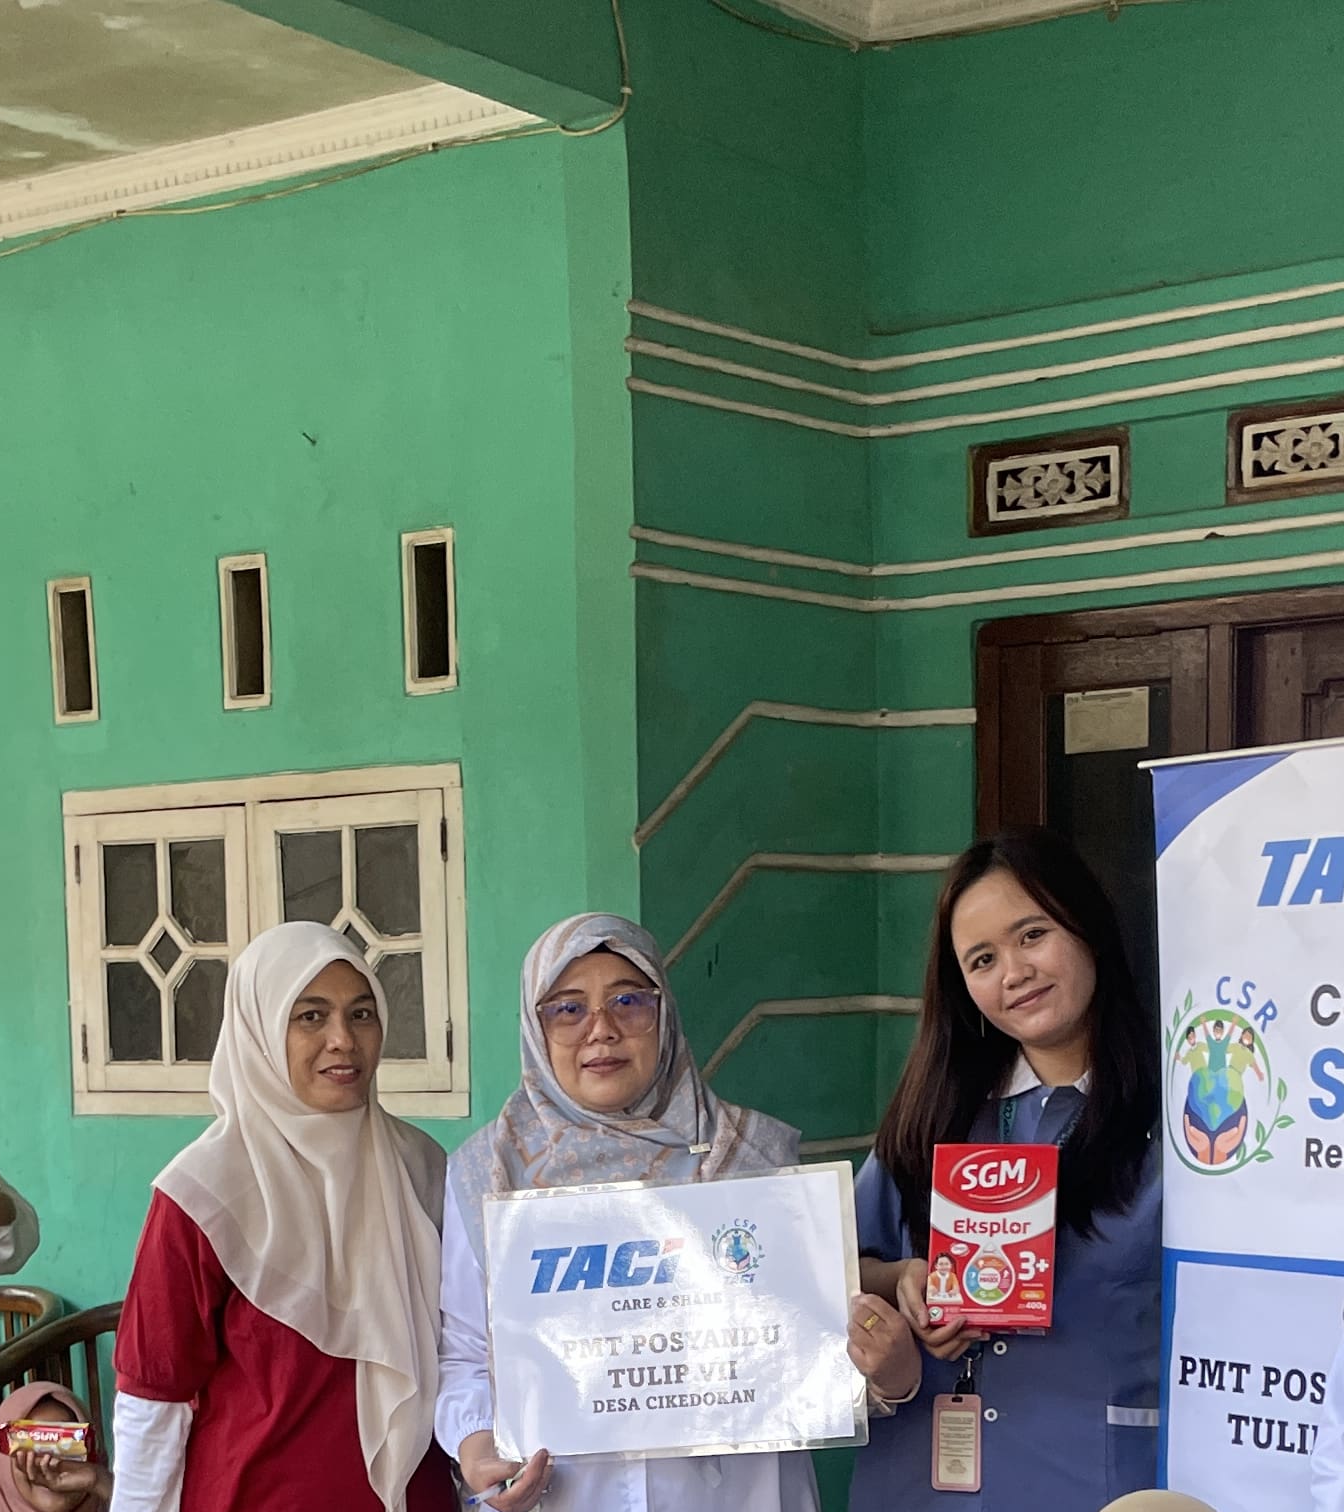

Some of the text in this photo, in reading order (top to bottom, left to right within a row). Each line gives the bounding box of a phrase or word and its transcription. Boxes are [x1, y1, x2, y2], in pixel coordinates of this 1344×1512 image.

[960, 1158, 1027, 1191] SGM
[953, 1218, 1032, 1237] Eksplor
[1018, 1251, 1049, 1280] 3+
[612, 1298, 652, 1312] CARE
[656, 1297, 668, 1308] &
[562, 1324, 782, 1359] PMT POSYANDU
[608, 1364, 689, 1389] TULIP
[1179, 1355, 1251, 1394] PMT
[593, 1388, 756, 1414] DESA CIKEDOKAN
